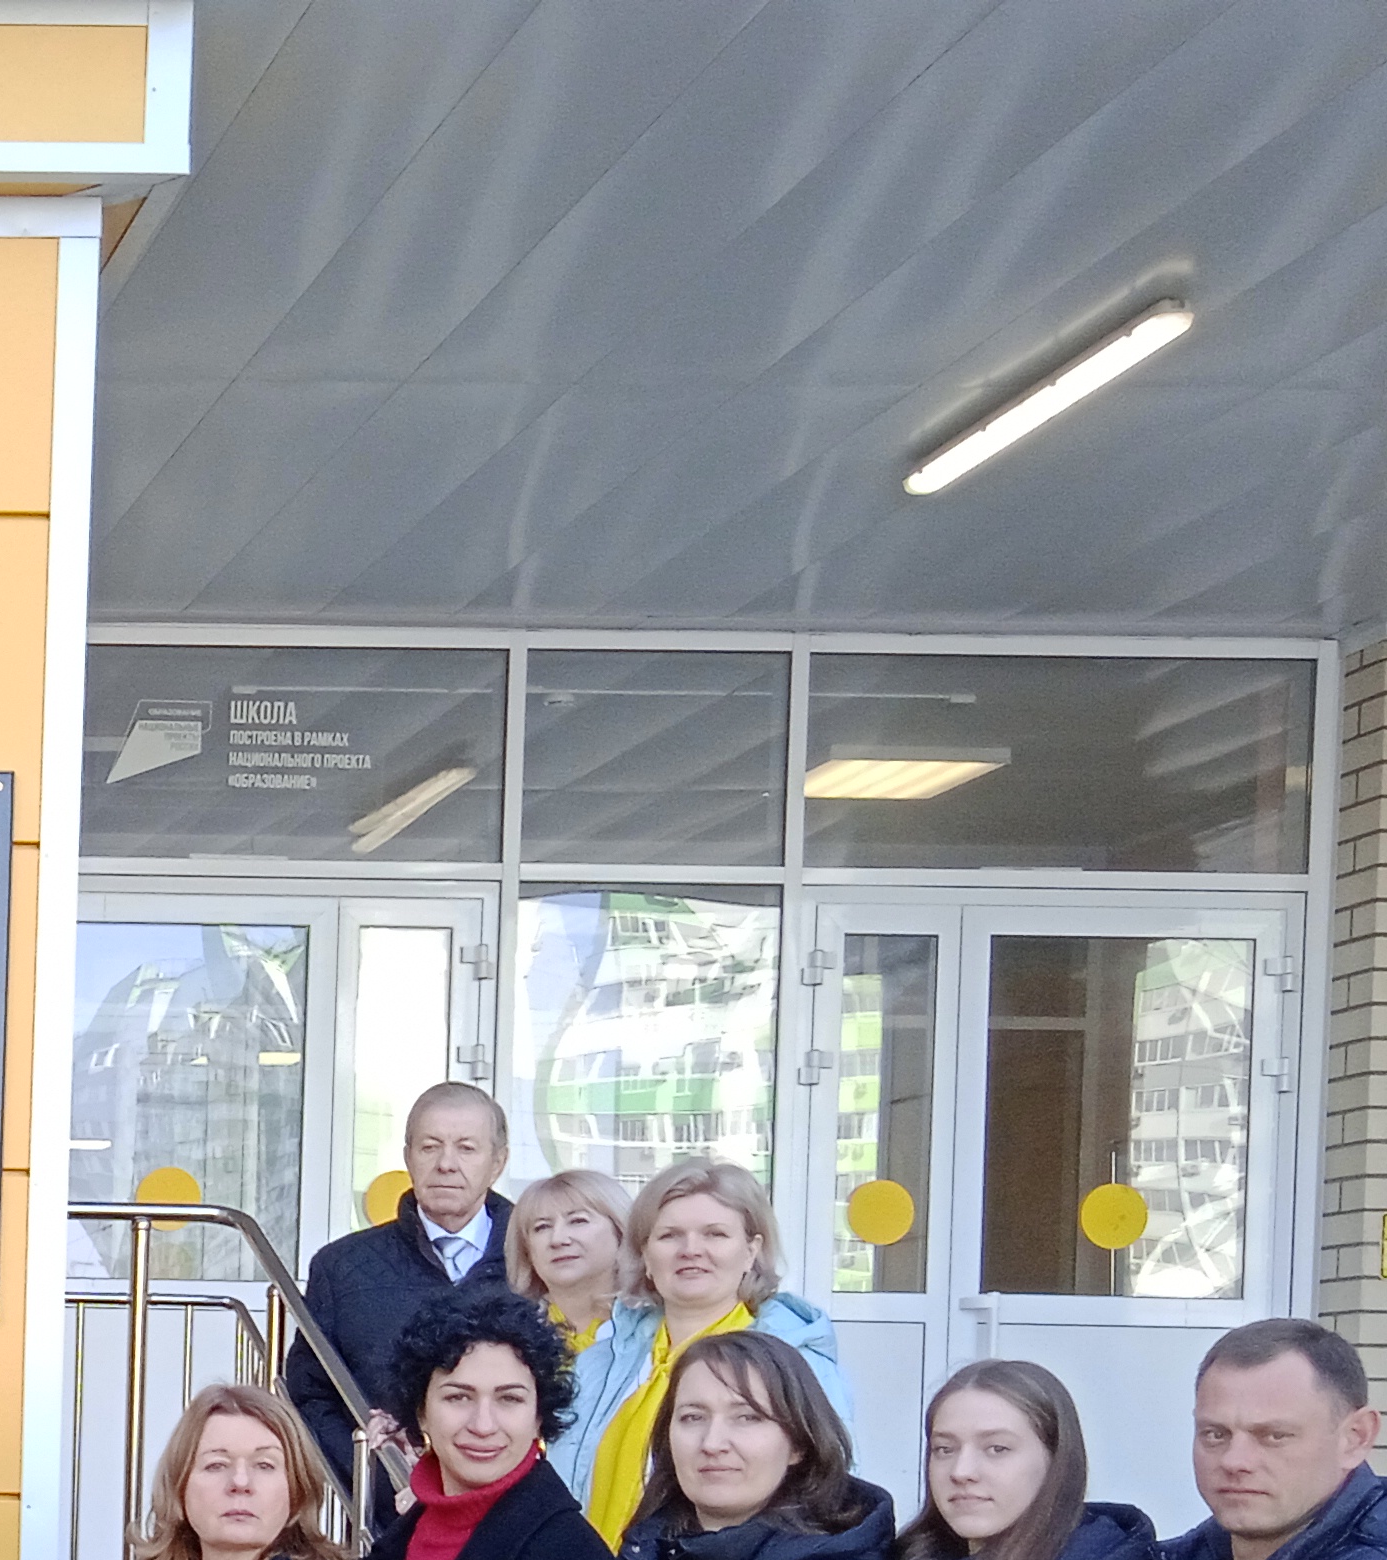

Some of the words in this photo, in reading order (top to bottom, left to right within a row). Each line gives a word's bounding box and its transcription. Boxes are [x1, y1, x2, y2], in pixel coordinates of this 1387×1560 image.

[230, 700, 297, 724] ШКОЛА
[229, 730, 292, 746] ПОСТРОЕНА
[293, 732, 302, 746] В
[304, 732, 349, 747] РАМКАХ
[228, 752, 322, 768] НАЦИОНАЛЬНОГО
[323, 754, 372, 770] ПРОЕКТА
[228, 773, 317, 790] «ОБРАЗОВАНИЕ»
